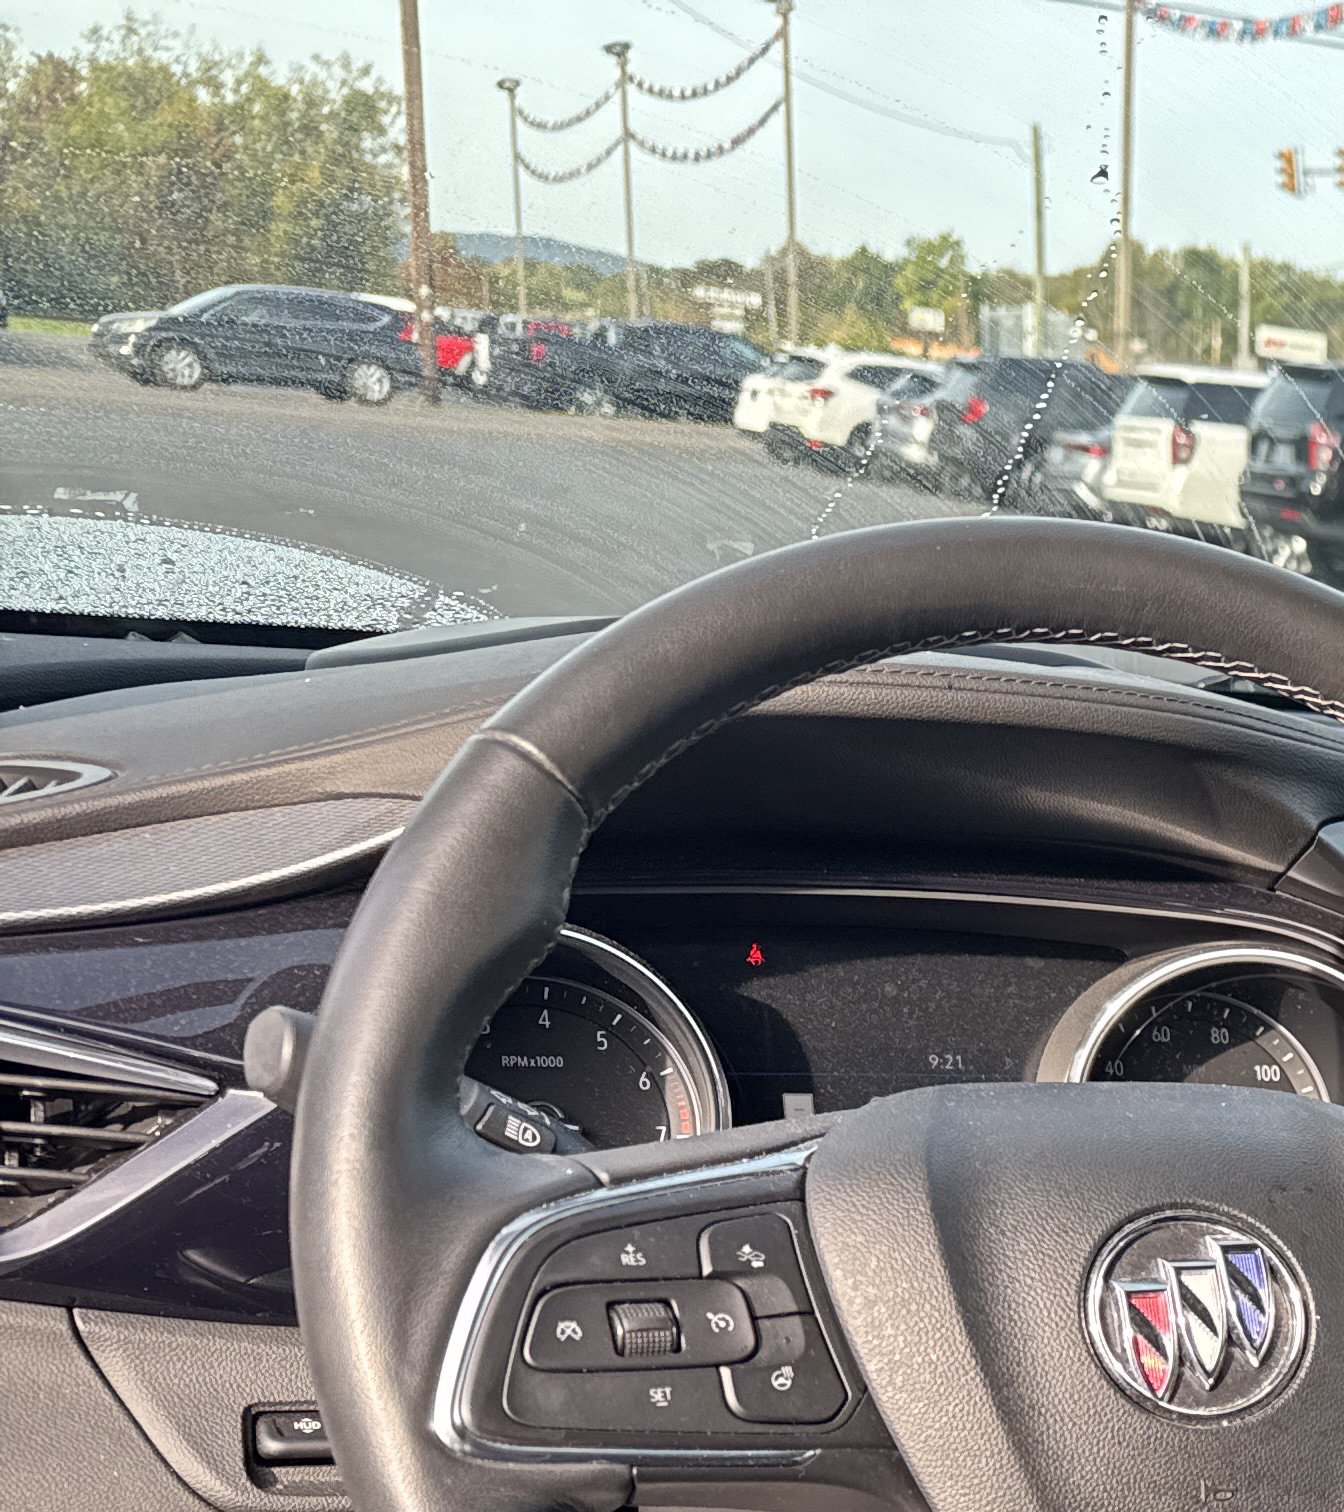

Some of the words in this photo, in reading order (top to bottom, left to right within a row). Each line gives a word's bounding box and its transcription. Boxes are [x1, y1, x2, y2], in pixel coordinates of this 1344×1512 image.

[538, 1009, 551, 1029] 4
[596, 1031, 609, 1051] 5
[1152, 1026, 1171, 1043] 60
[1211, 1027, 1230, 1045] 80
[929, 1054, 964, 1070] 9:21
[1104, 1060, 1124, 1077] 40
[638, 1072, 651, 1091] 6
[1254, 1065, 1281, 1082] 100
[620, 1253, 647, 1266] RES
[649, 1387, 672, 1402] SET
[293, 1421, 322, 1430] HUD
